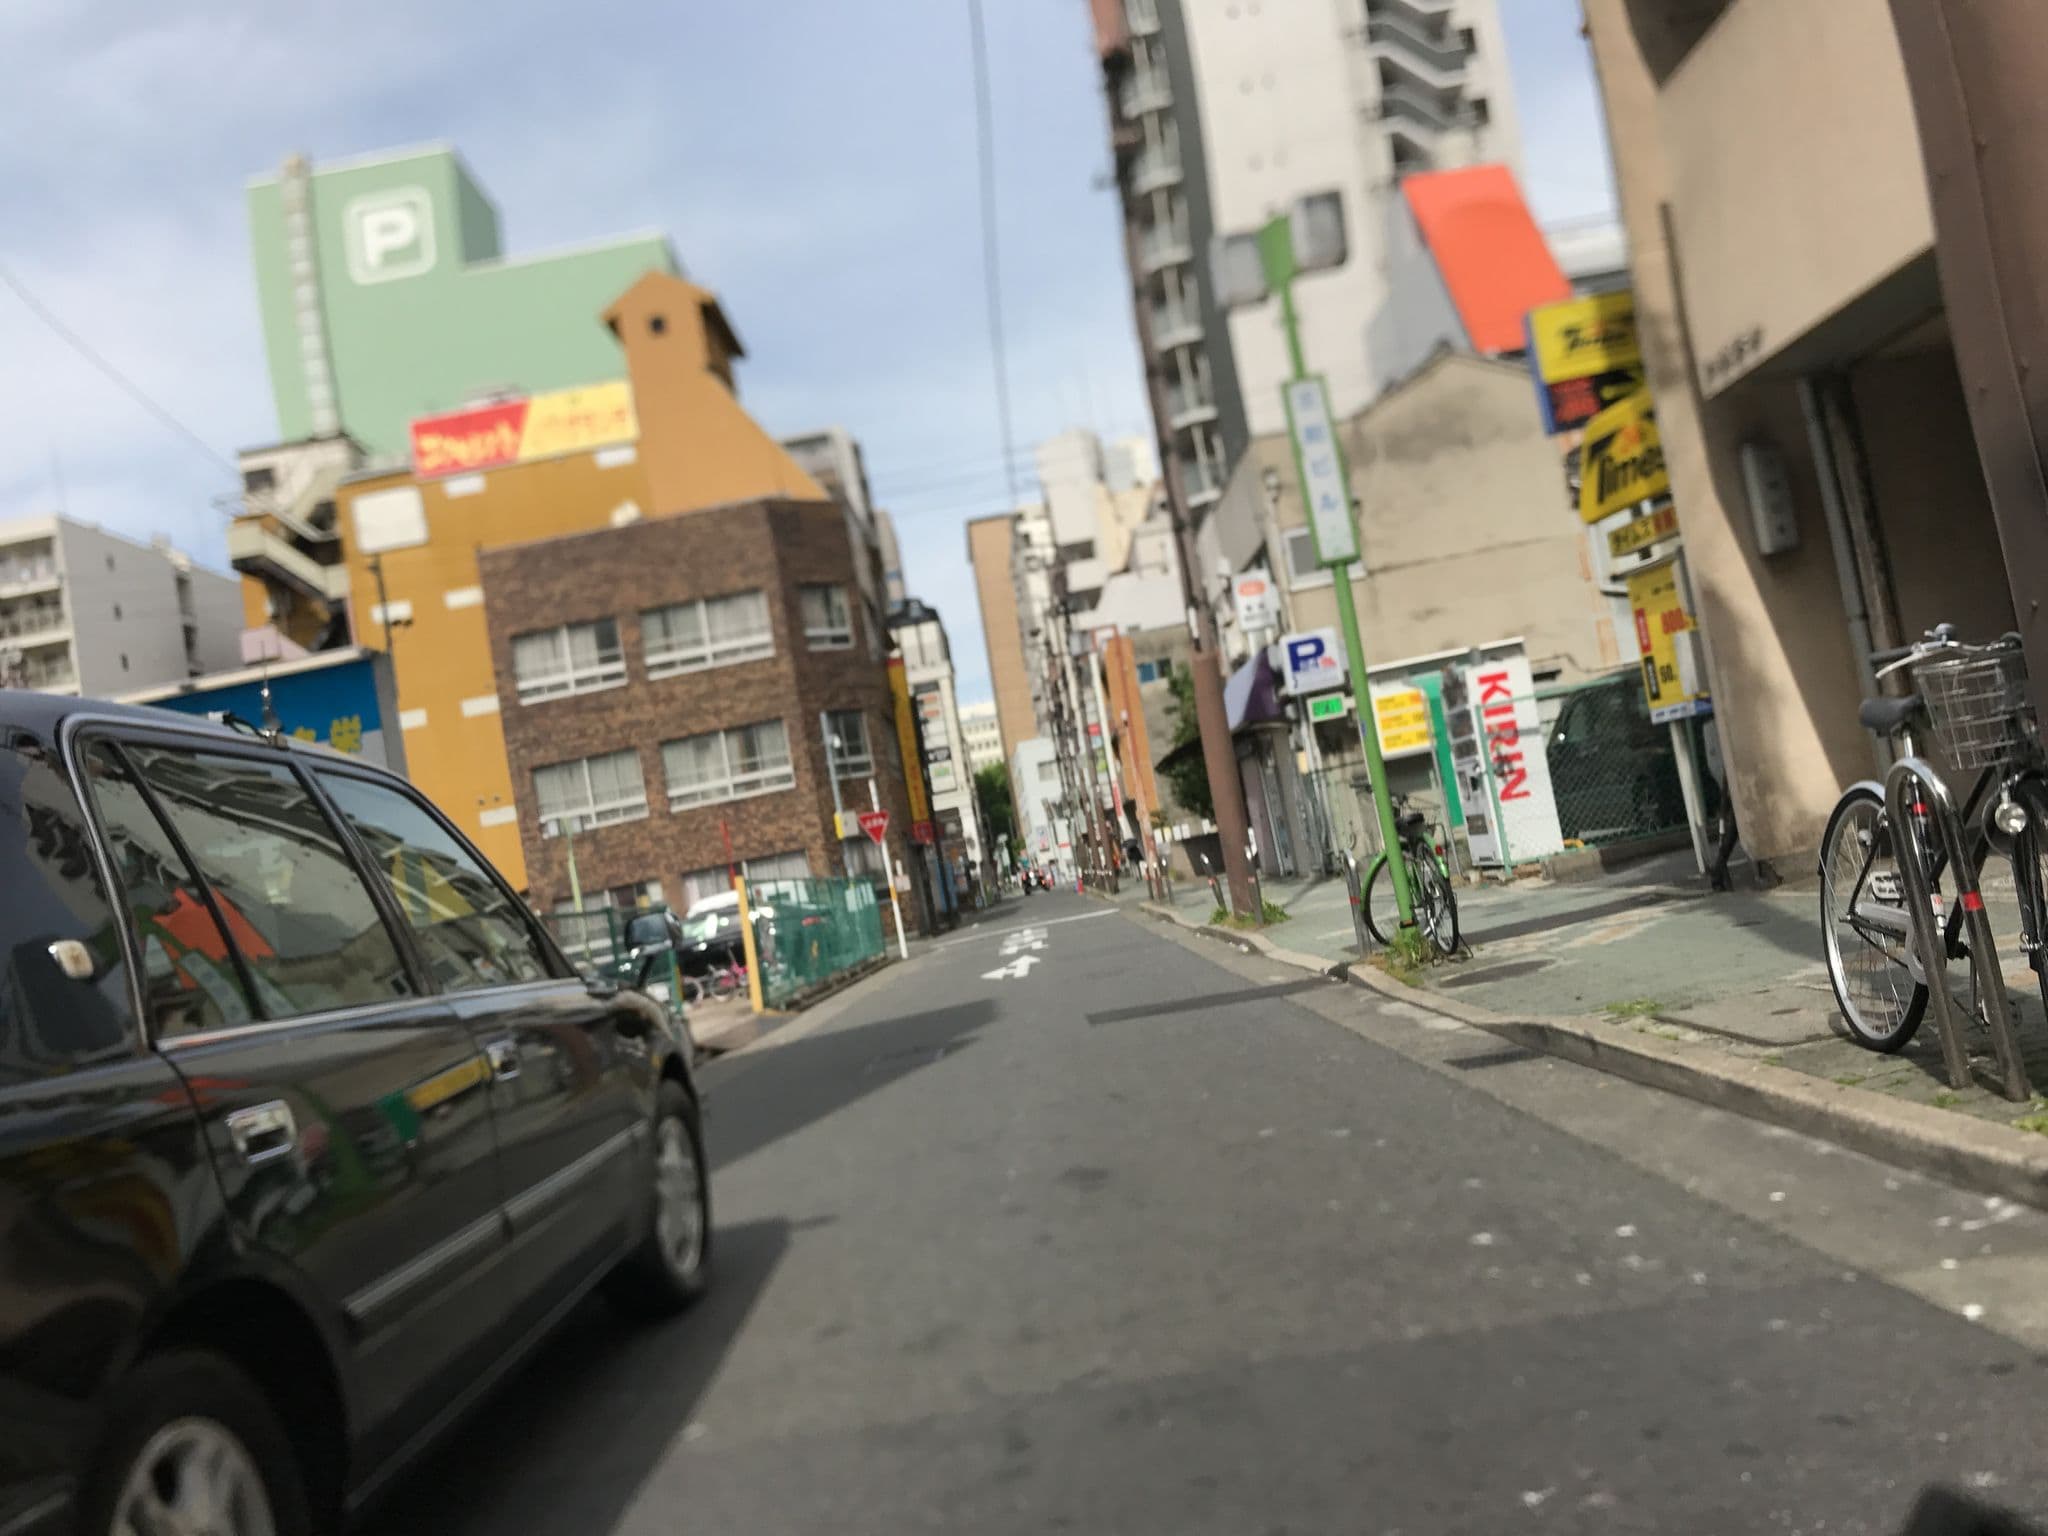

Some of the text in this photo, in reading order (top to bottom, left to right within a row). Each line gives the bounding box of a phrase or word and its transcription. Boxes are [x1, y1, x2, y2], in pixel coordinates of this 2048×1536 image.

[363, 209, 416, 266] P
[1288, 637, 1325, 672] P
[1477, 672, 1531, 801] KIRIN
